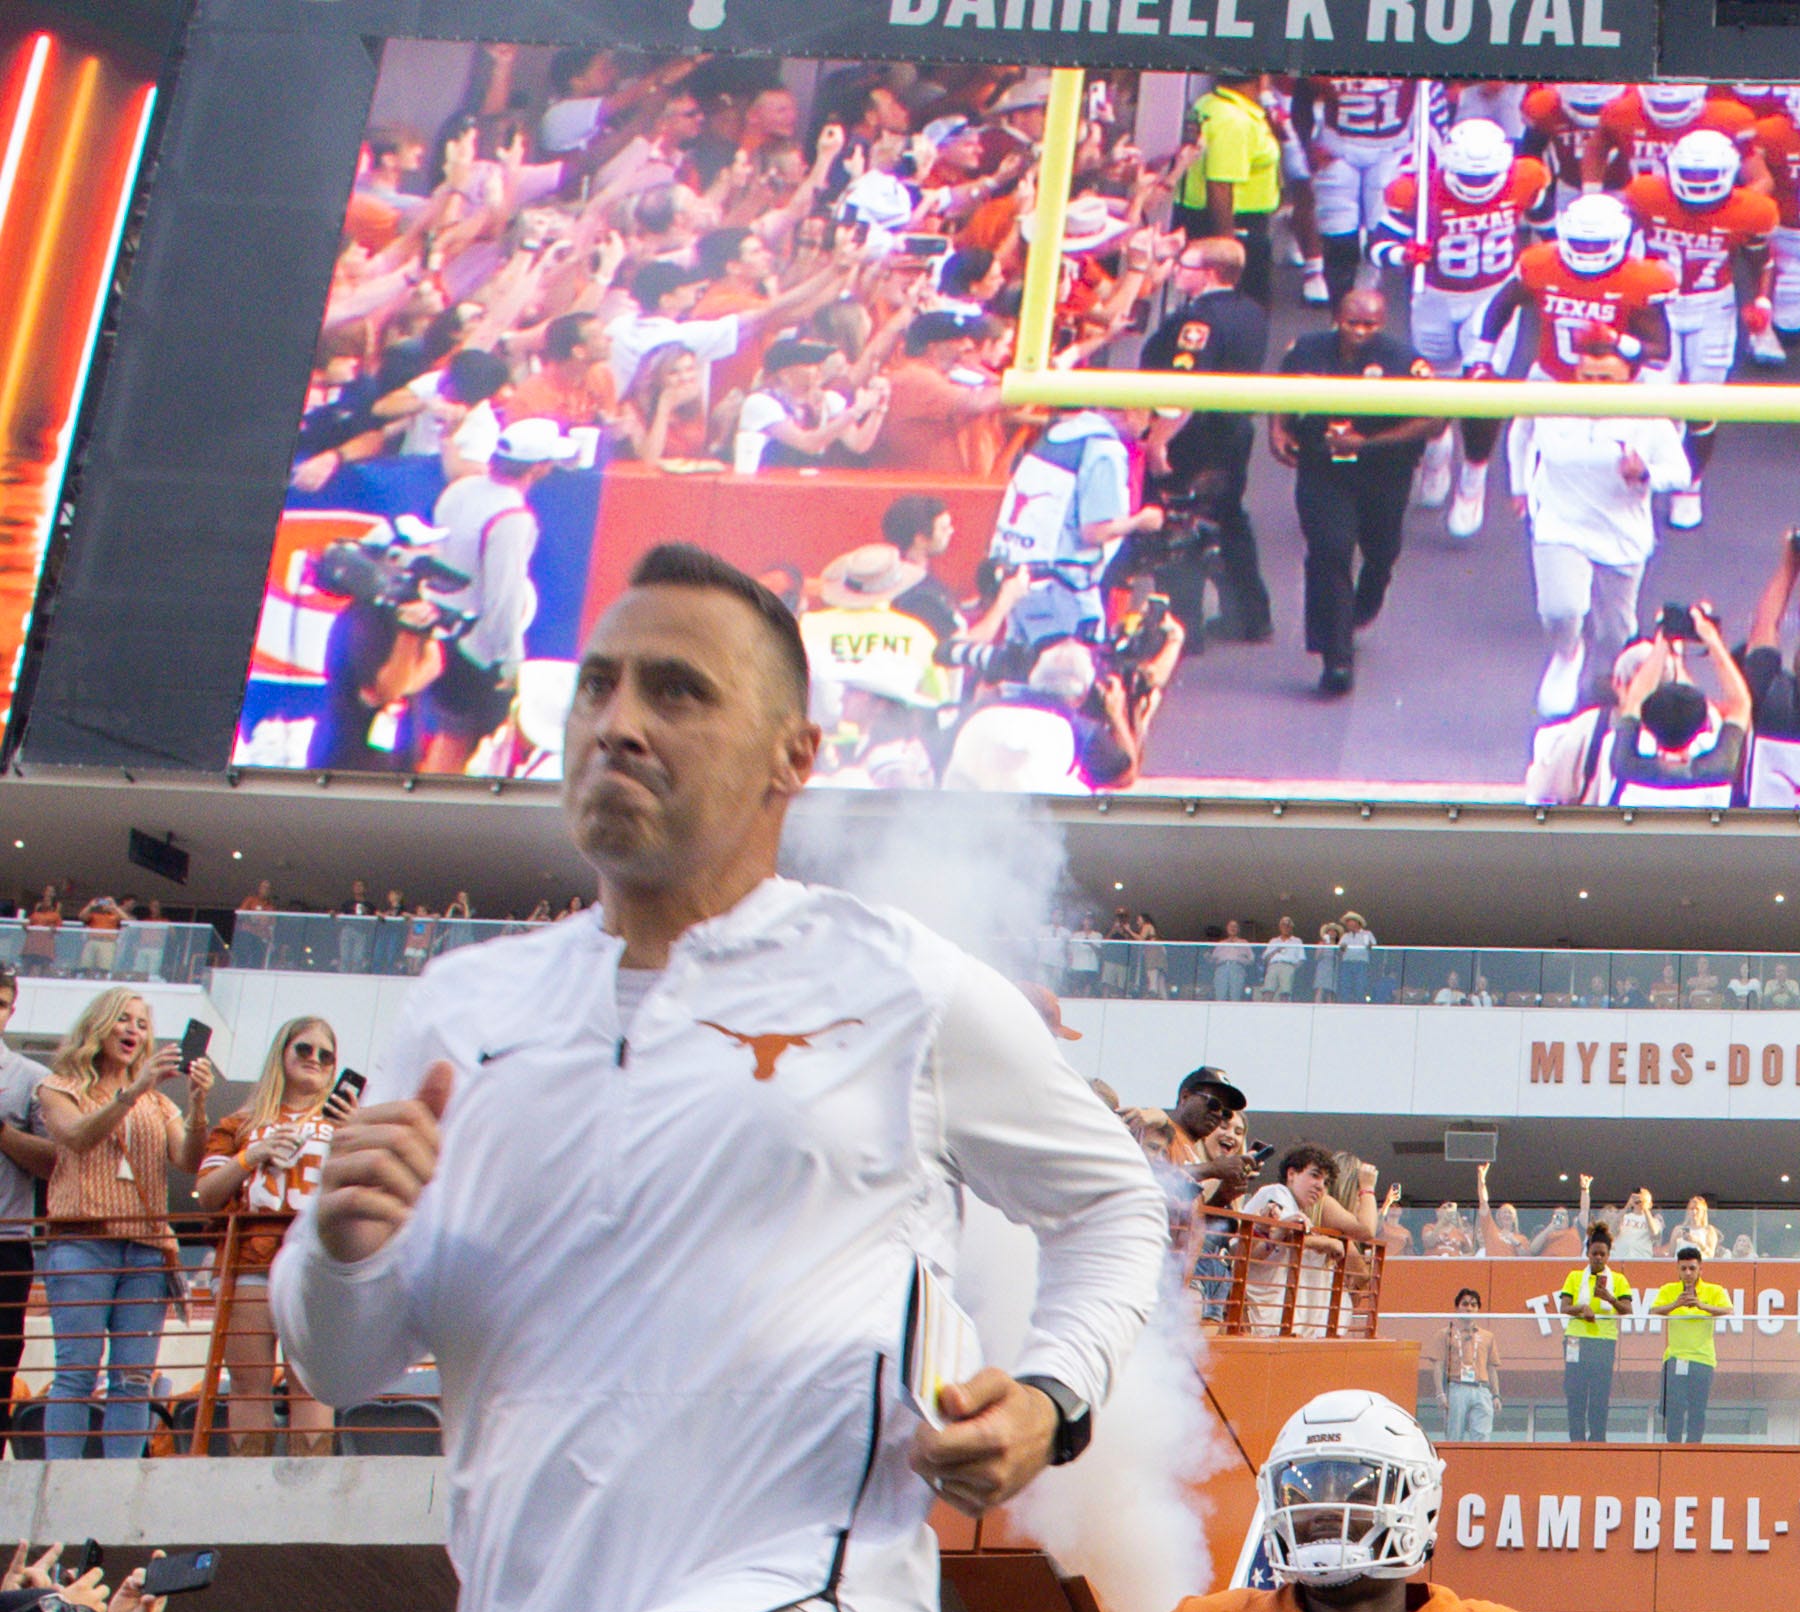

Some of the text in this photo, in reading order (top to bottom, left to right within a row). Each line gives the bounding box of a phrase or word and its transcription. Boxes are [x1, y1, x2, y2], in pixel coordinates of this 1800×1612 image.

[1366, 0, 1621, 47] ROYAL
[1441, 208, 1516, 234] TEXAS
[1653, 227, 1726, 251] TEXAS
[1544, 294, 1616, 322] TEXAS
